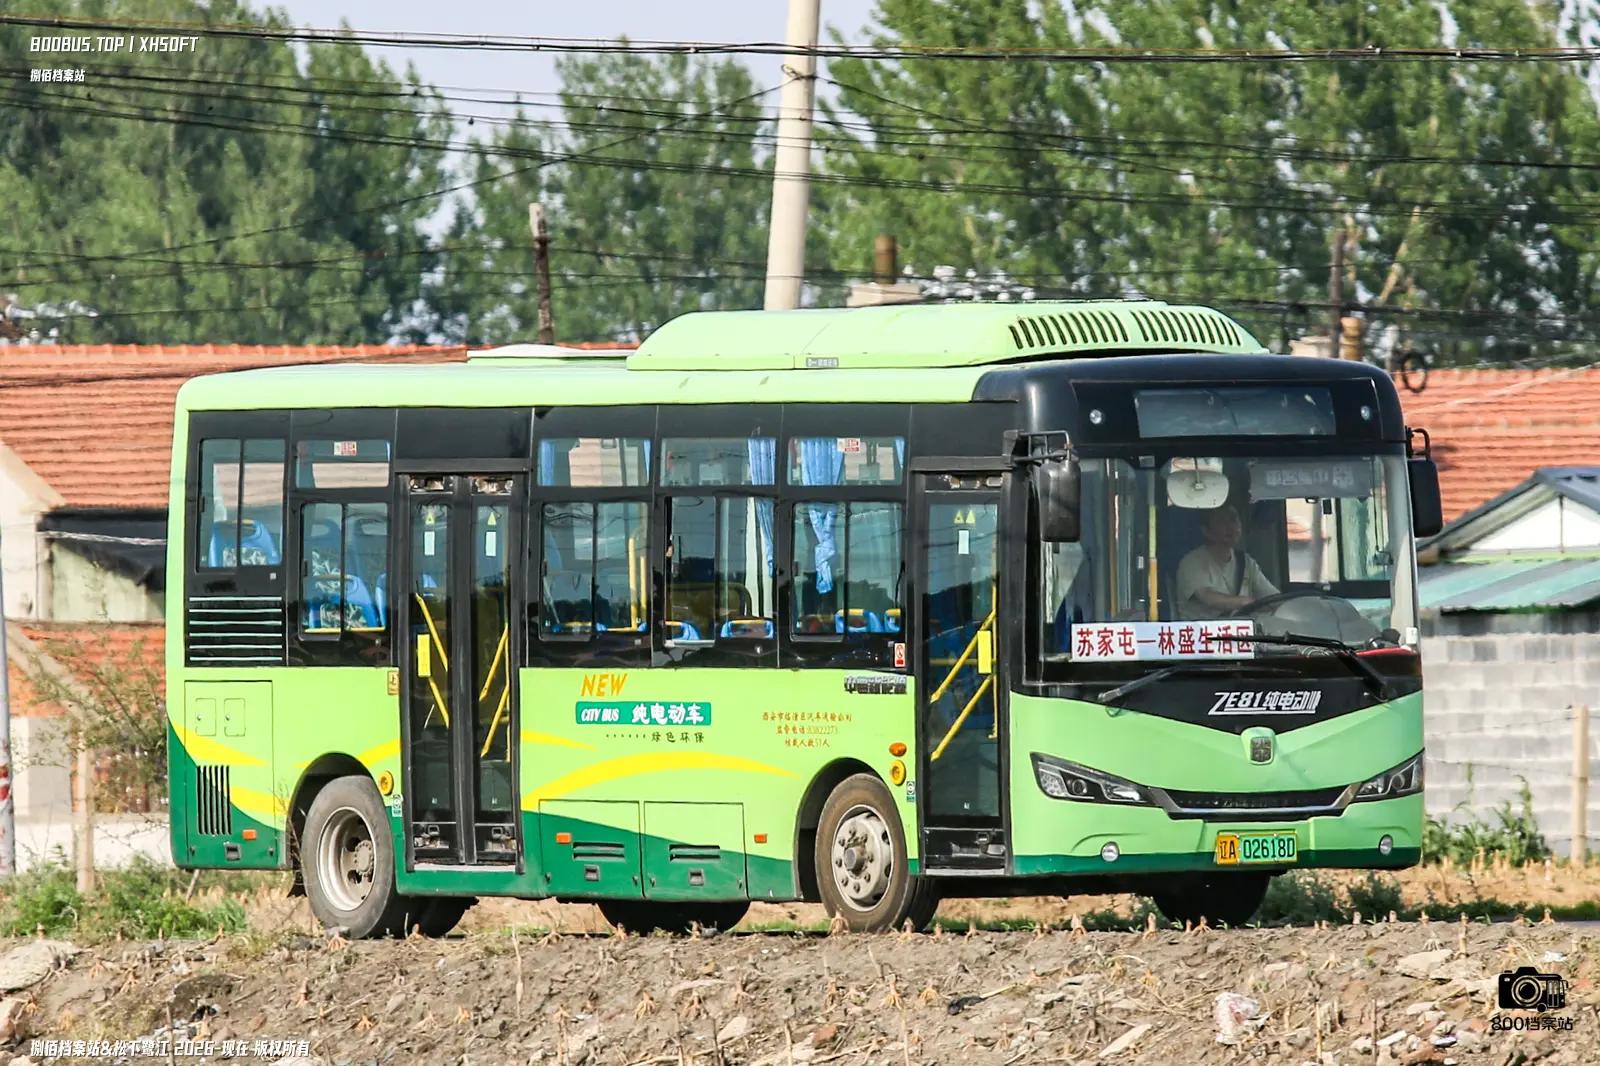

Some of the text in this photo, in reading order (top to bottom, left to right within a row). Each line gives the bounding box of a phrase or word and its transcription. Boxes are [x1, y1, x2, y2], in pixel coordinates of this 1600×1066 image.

[581, 673, 628, 697] NEW
[581, 703, 705, 725] CITY BUS 纯电动车
